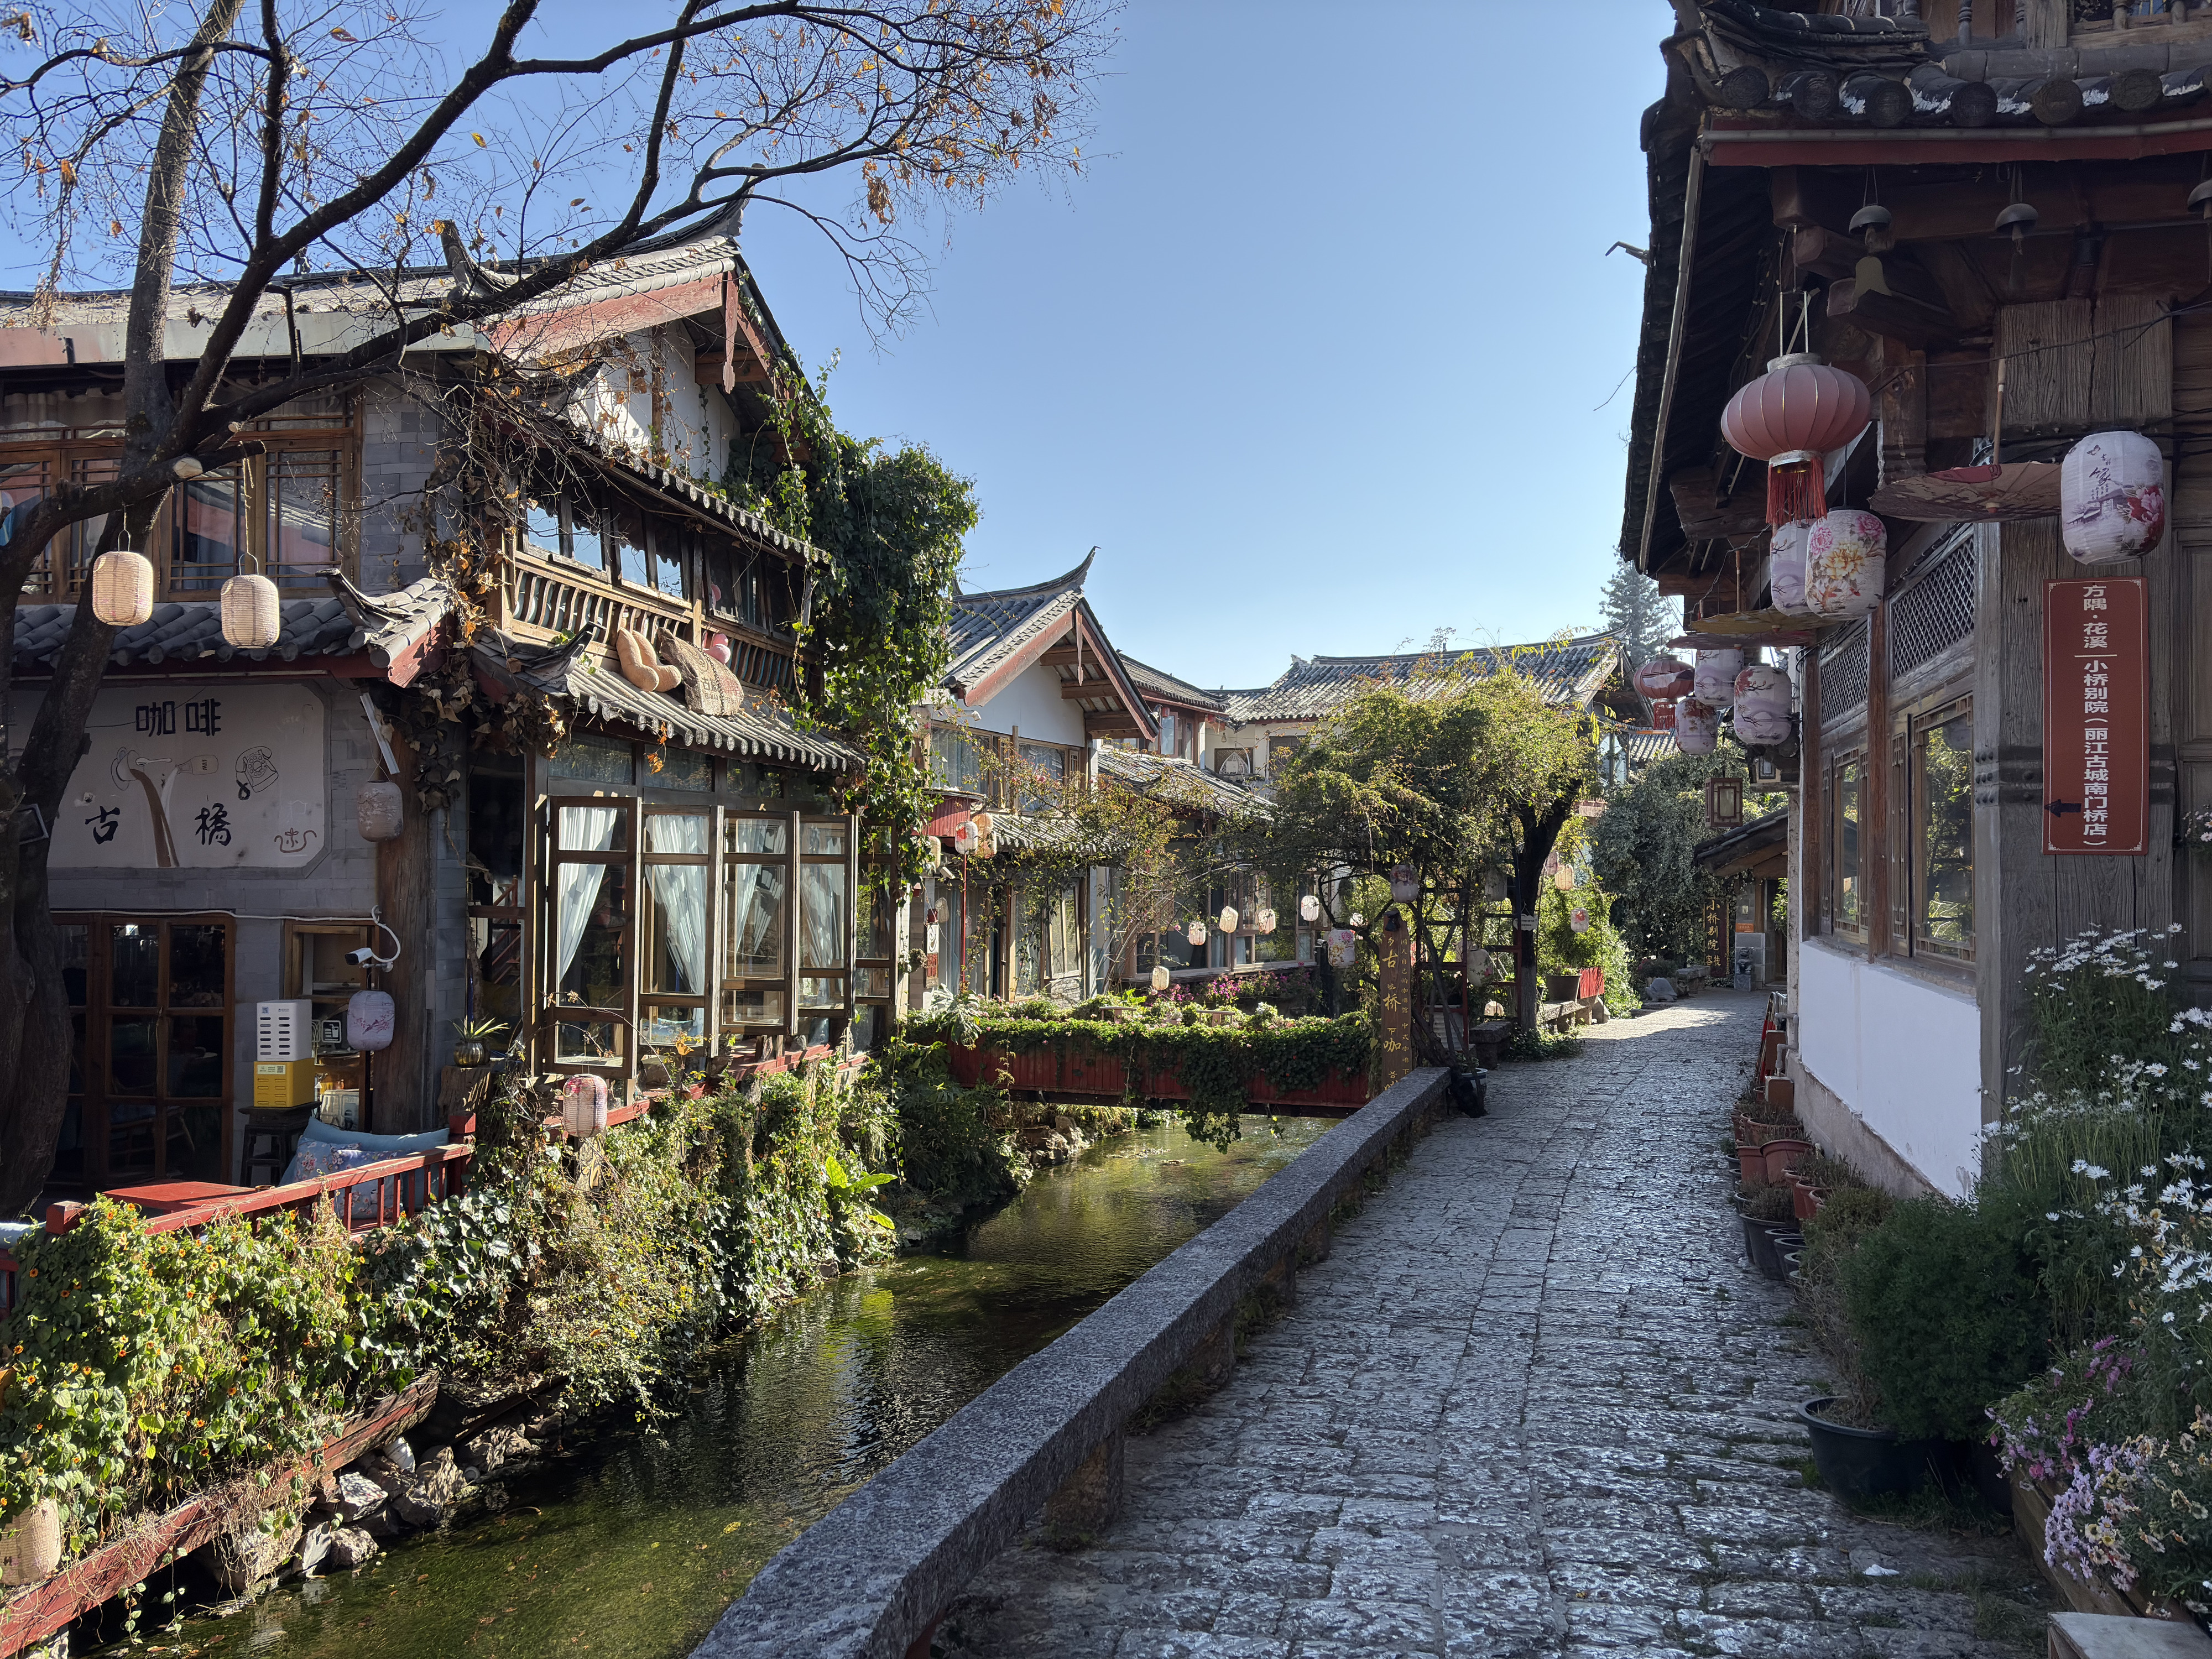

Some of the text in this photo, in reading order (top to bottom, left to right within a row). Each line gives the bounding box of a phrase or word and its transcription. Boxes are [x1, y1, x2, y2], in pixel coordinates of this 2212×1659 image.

[2083, 585, 2107, 649] 方隅·花溪
[136, 698, 221, 737] 咖啡
[1706, 900, 1720, 951] 小桥别院
[1705, 954, 1721, 966] 客栈
